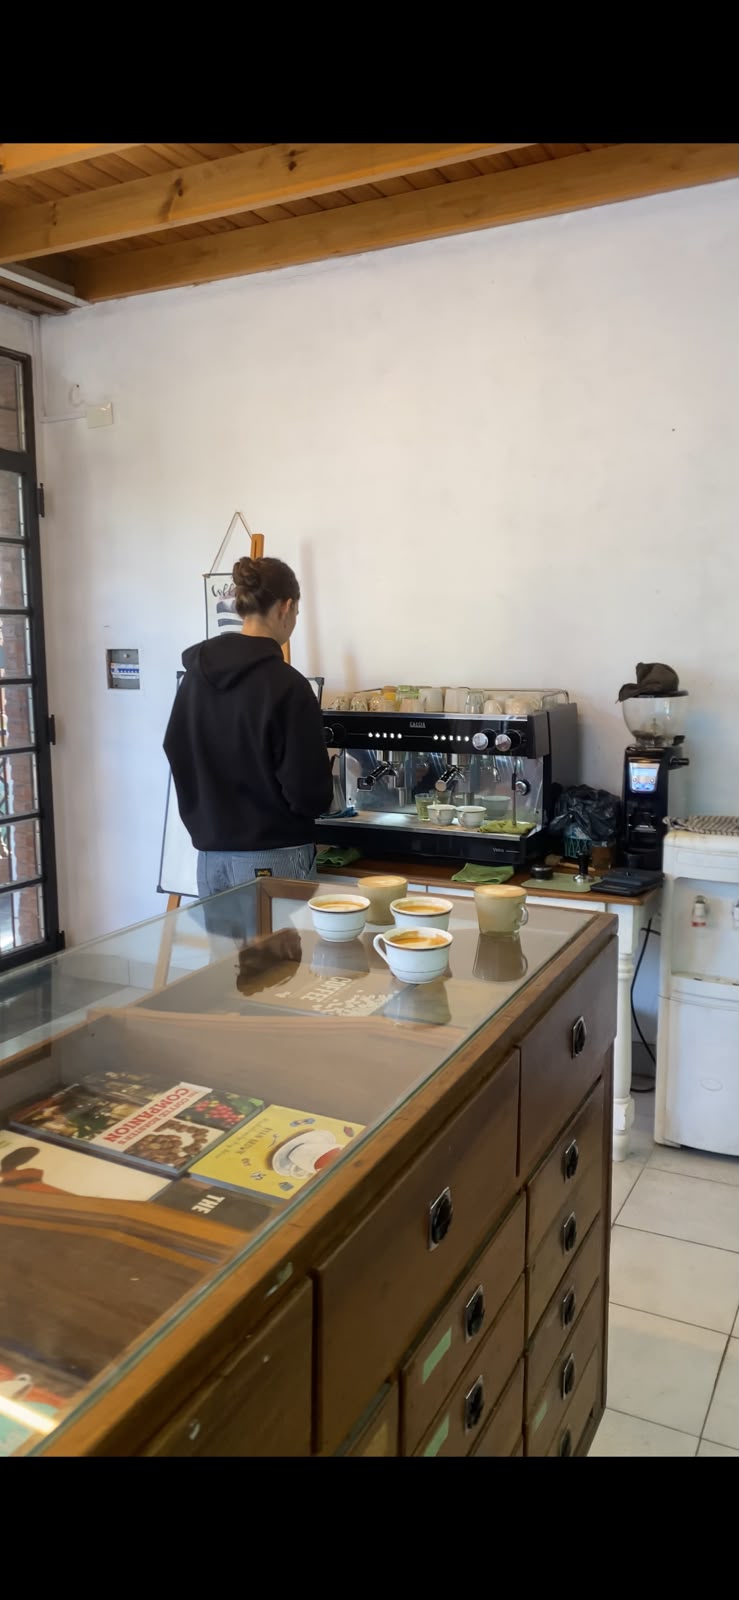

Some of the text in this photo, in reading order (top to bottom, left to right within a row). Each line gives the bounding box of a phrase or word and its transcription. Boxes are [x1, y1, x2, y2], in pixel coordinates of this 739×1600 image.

[300, 976, 353, 1002] COFFEE
[102, 1087, 190, 1143] COMPANION
[159, 1096, 190, 1118] COFFEE
[191, 1194, 226, 1214] THE
